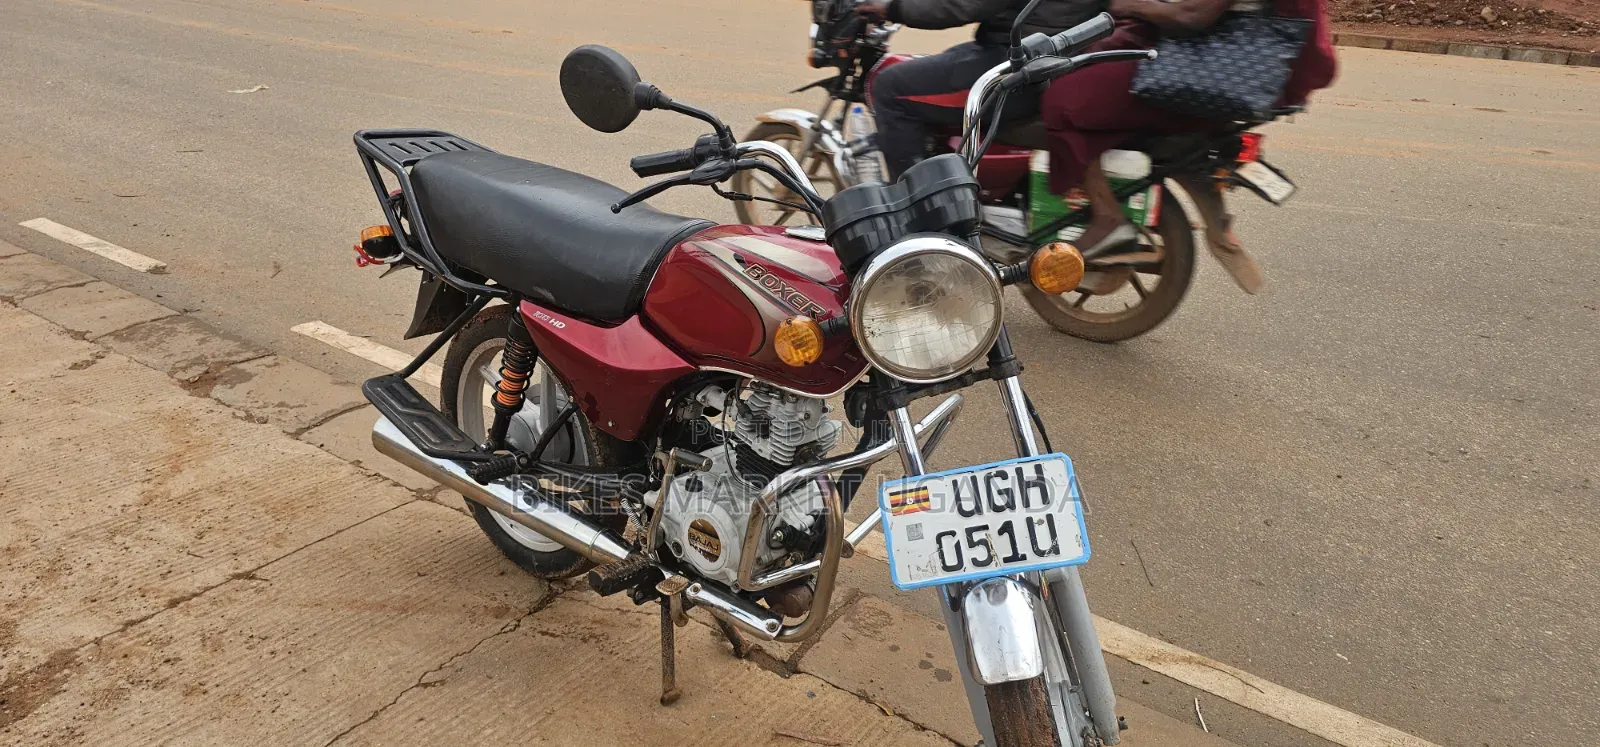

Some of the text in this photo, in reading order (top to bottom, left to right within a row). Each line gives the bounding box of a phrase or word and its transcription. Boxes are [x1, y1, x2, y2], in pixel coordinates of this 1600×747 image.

[743, 263, 827, 322] BOXER
[549, 318, 566, 329] HD
[952, 463, 1050, 518] UGH
[690, 533, 719, 551] BAJAJ
[935, 513, 1061, 572] 051U
